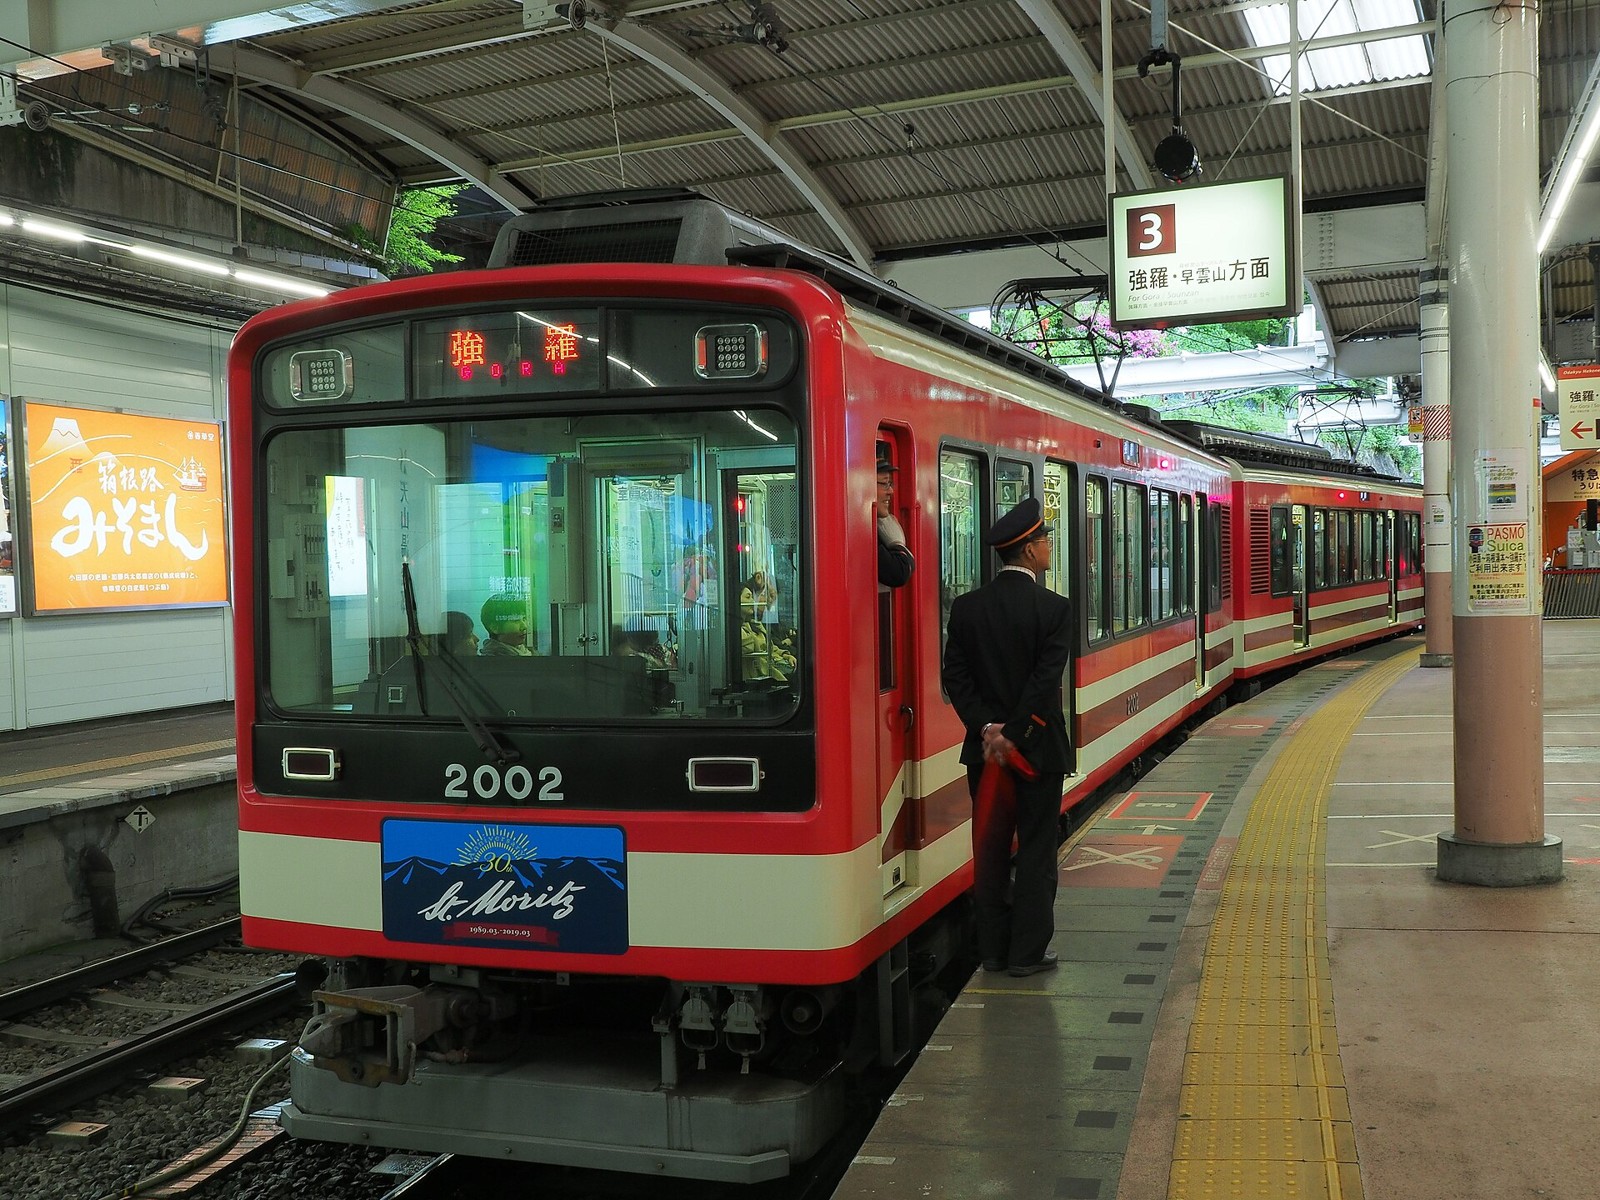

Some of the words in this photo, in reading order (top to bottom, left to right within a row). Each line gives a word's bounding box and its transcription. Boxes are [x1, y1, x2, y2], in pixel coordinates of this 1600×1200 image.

[1138, 212, 1164, 251] 3
[1128, 256, 1271, 292] 強羅・早雲山方面
[1128, 294, 1140, 302] For
[1141, 293, 1160, 301] Gora
[451, 324, 579, 366] 強羅
[459, 360, 566, 381] GORA
[97, 458, 165, 495] 箱根路
[51, 492, 209, 561] みそまん
[1487, 526, 1525, 540] PASMO
[1487, 539, 1524, 552] Suica
[444, 763, 564, 801] 2002
[417, 881, 468, 921] St.
[457, 879, 586, 920] Moritz
